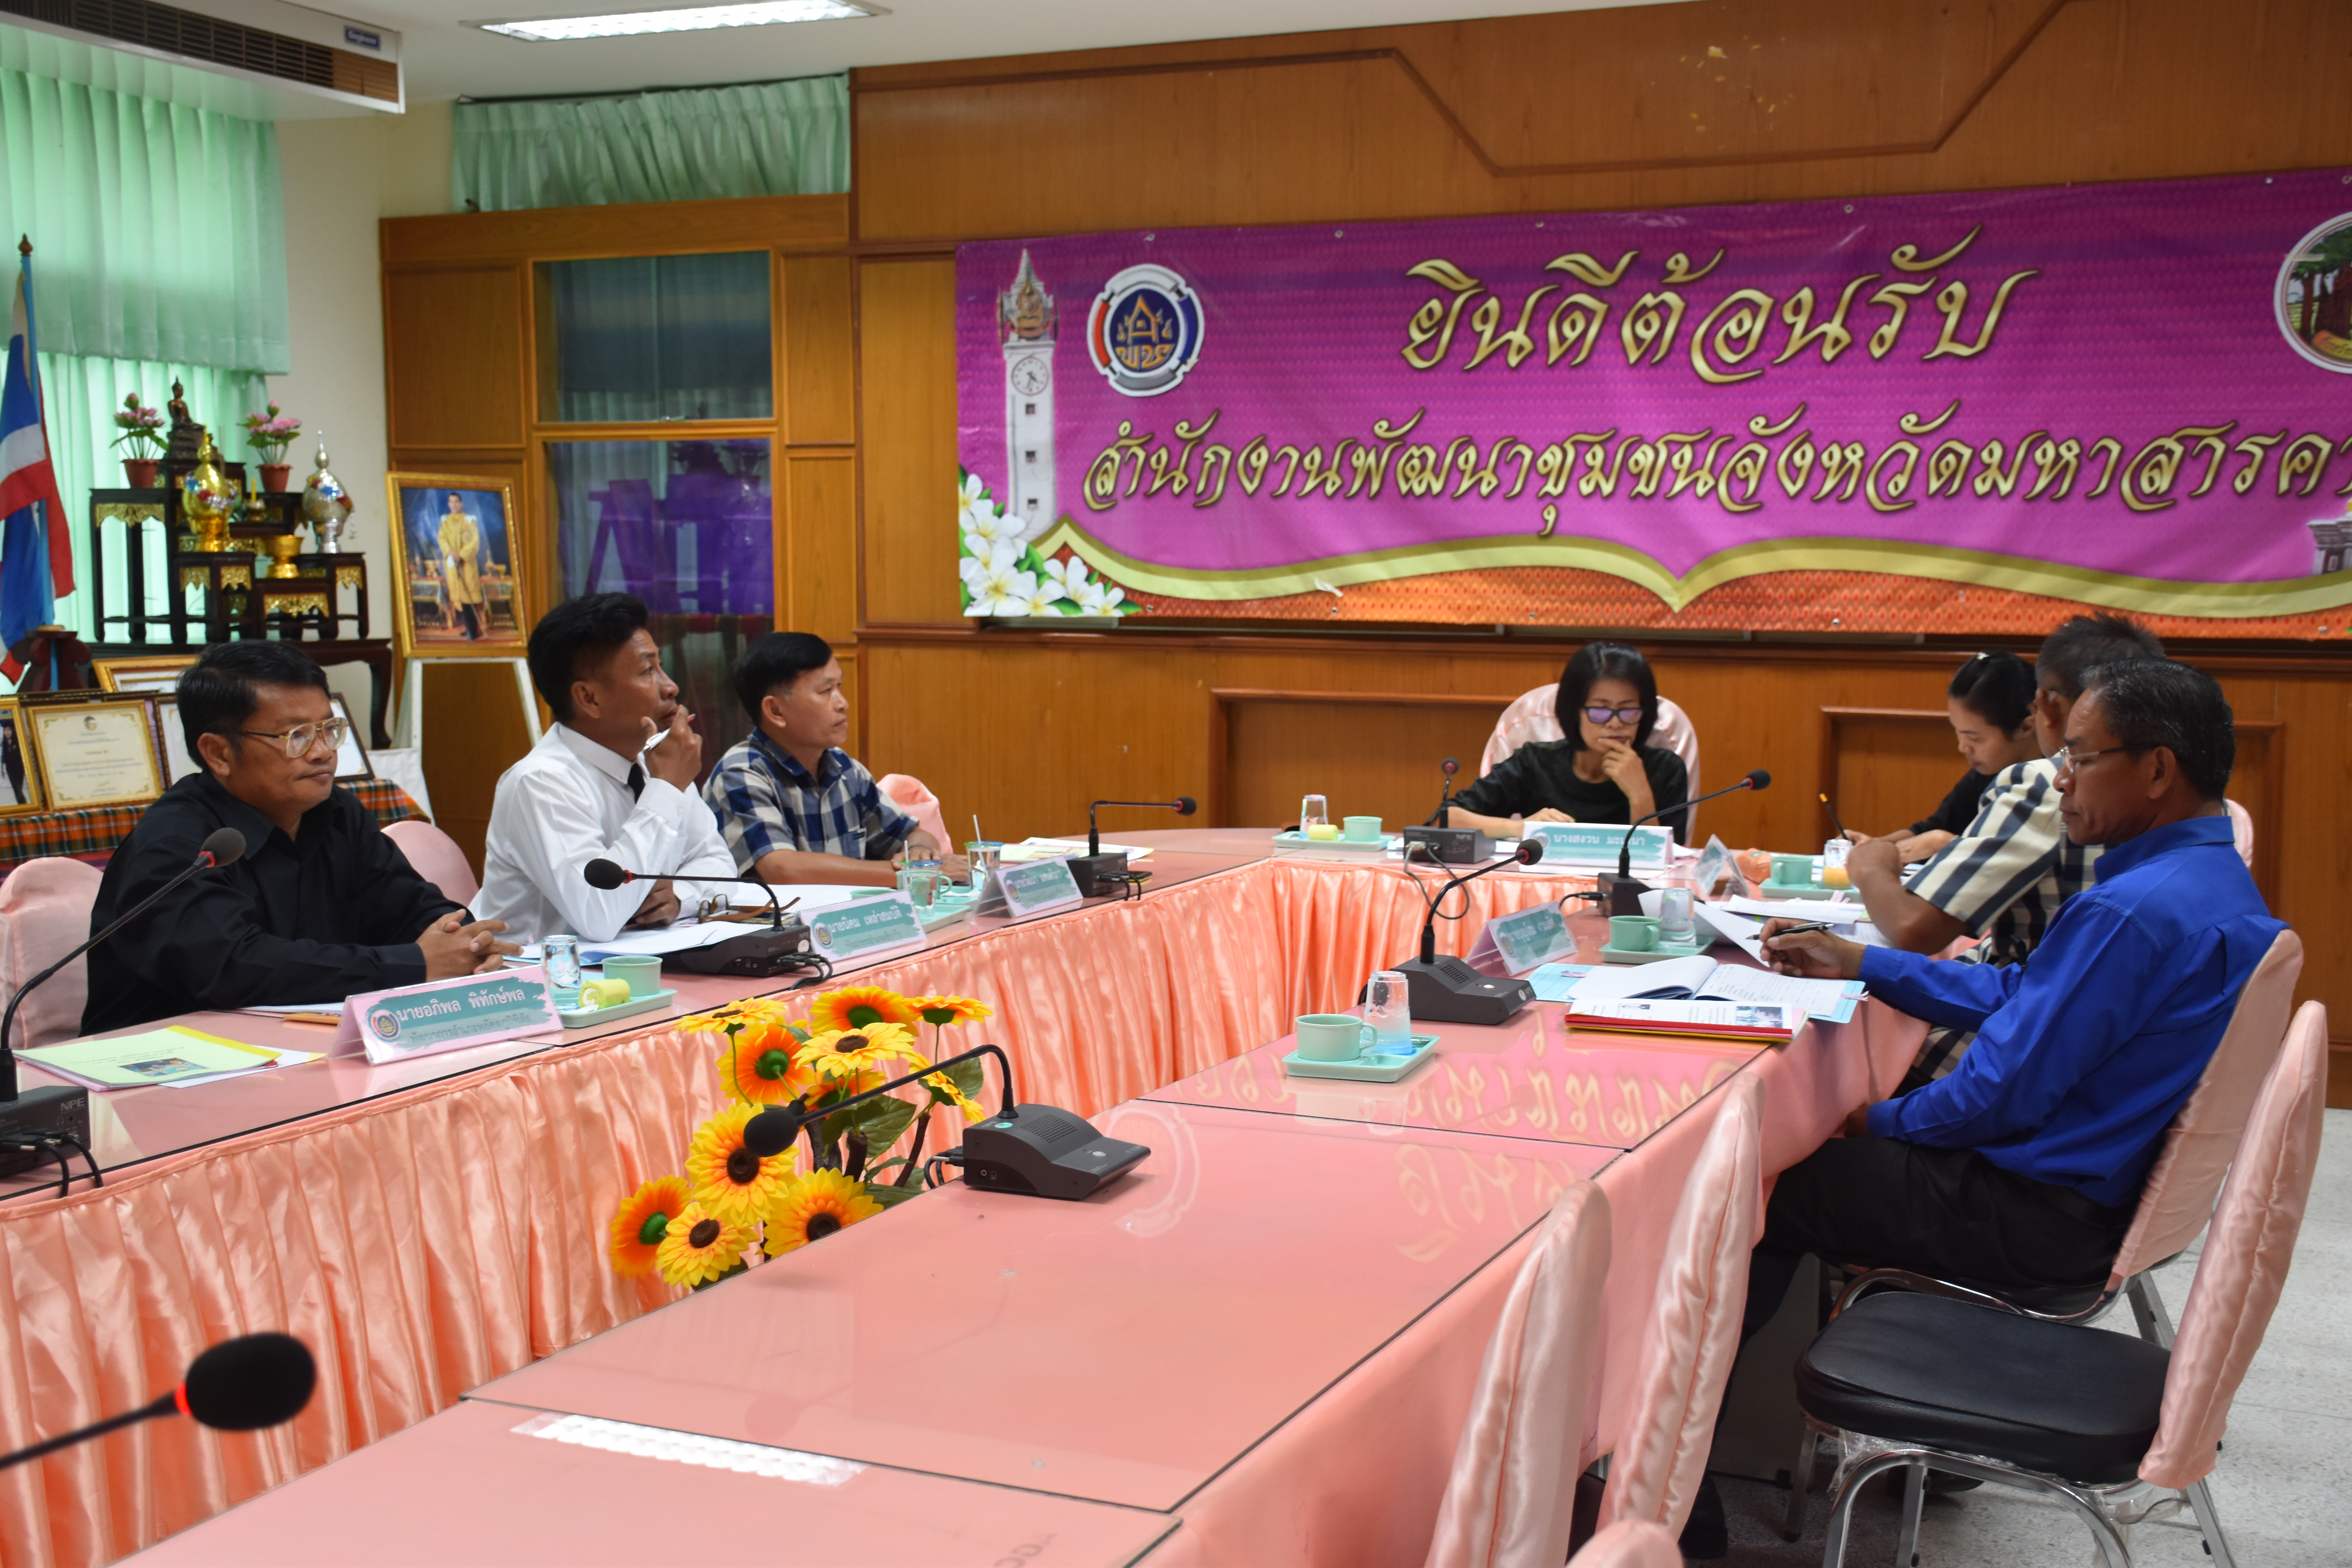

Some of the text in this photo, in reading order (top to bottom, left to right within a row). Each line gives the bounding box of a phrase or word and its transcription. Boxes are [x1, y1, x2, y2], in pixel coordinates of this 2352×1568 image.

[1399, 223, 2040, 385] ยินดีต้อนรับ
[396, 985, 525, 1021] นายอภิพล พิทักษ์พล
[60, 1097, 85, 1111] NPE
